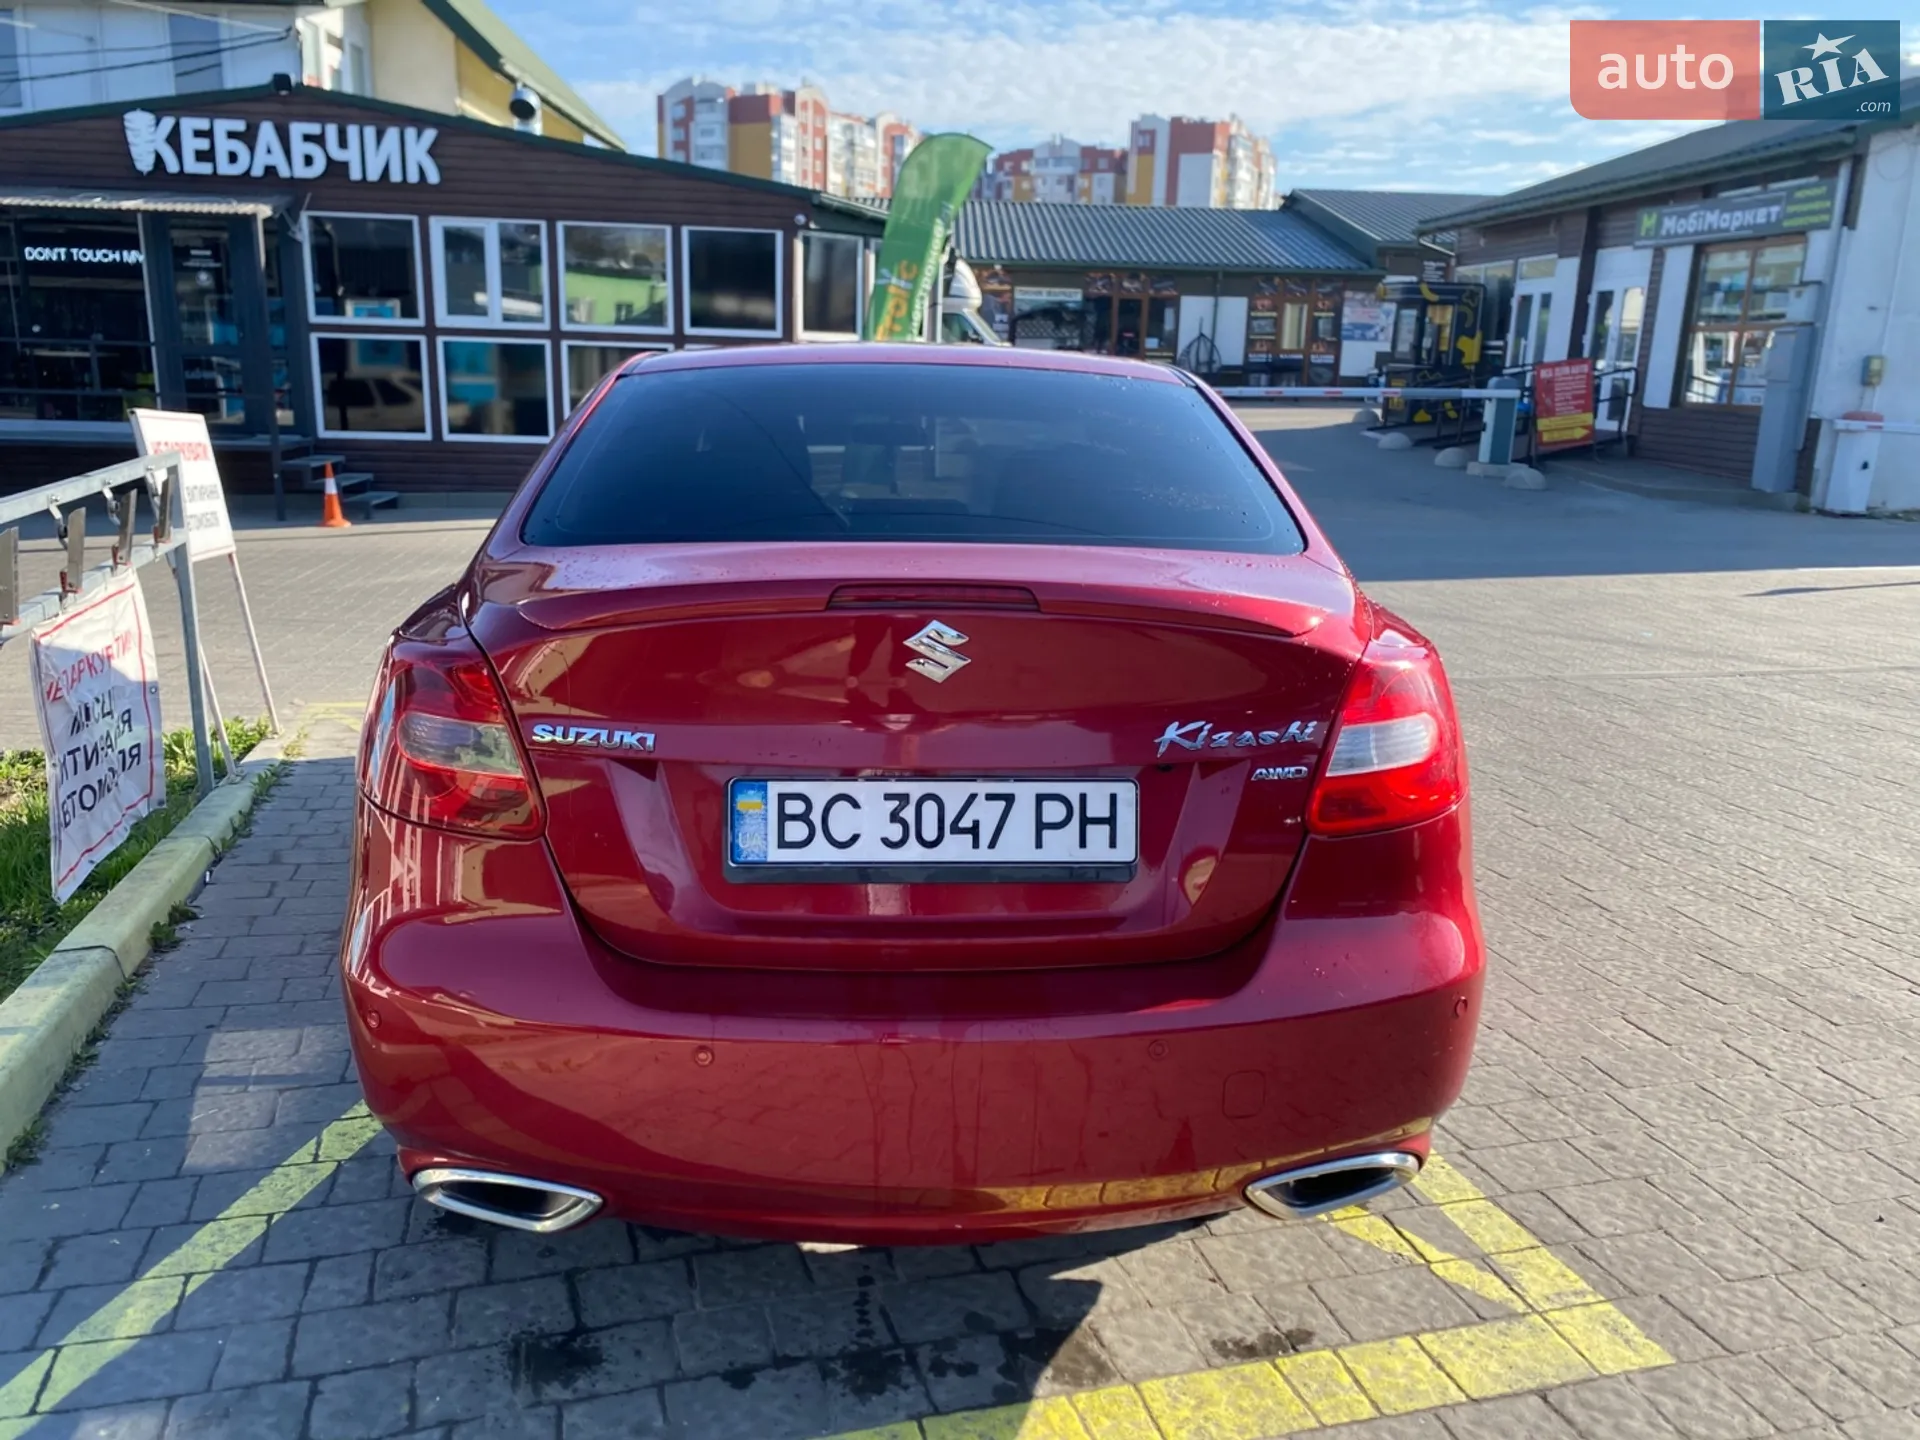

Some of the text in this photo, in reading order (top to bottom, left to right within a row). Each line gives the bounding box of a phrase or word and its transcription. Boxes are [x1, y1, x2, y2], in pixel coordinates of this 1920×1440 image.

[123, 108, 441, 185] КЕБАБЧИК
[1660, 205, 1782, 236] МобіМаркет
[24, 246, 67, 261] DON'T
[69, 248, 120, 263] TOUCH
[532, 724, 655, 751] SUZUKI
[1154, 720, 1318, 758] Kizashi
[1251, 766, 1308, 781] AWD
[776, 793, 1118, 850] BC 3047 PH
